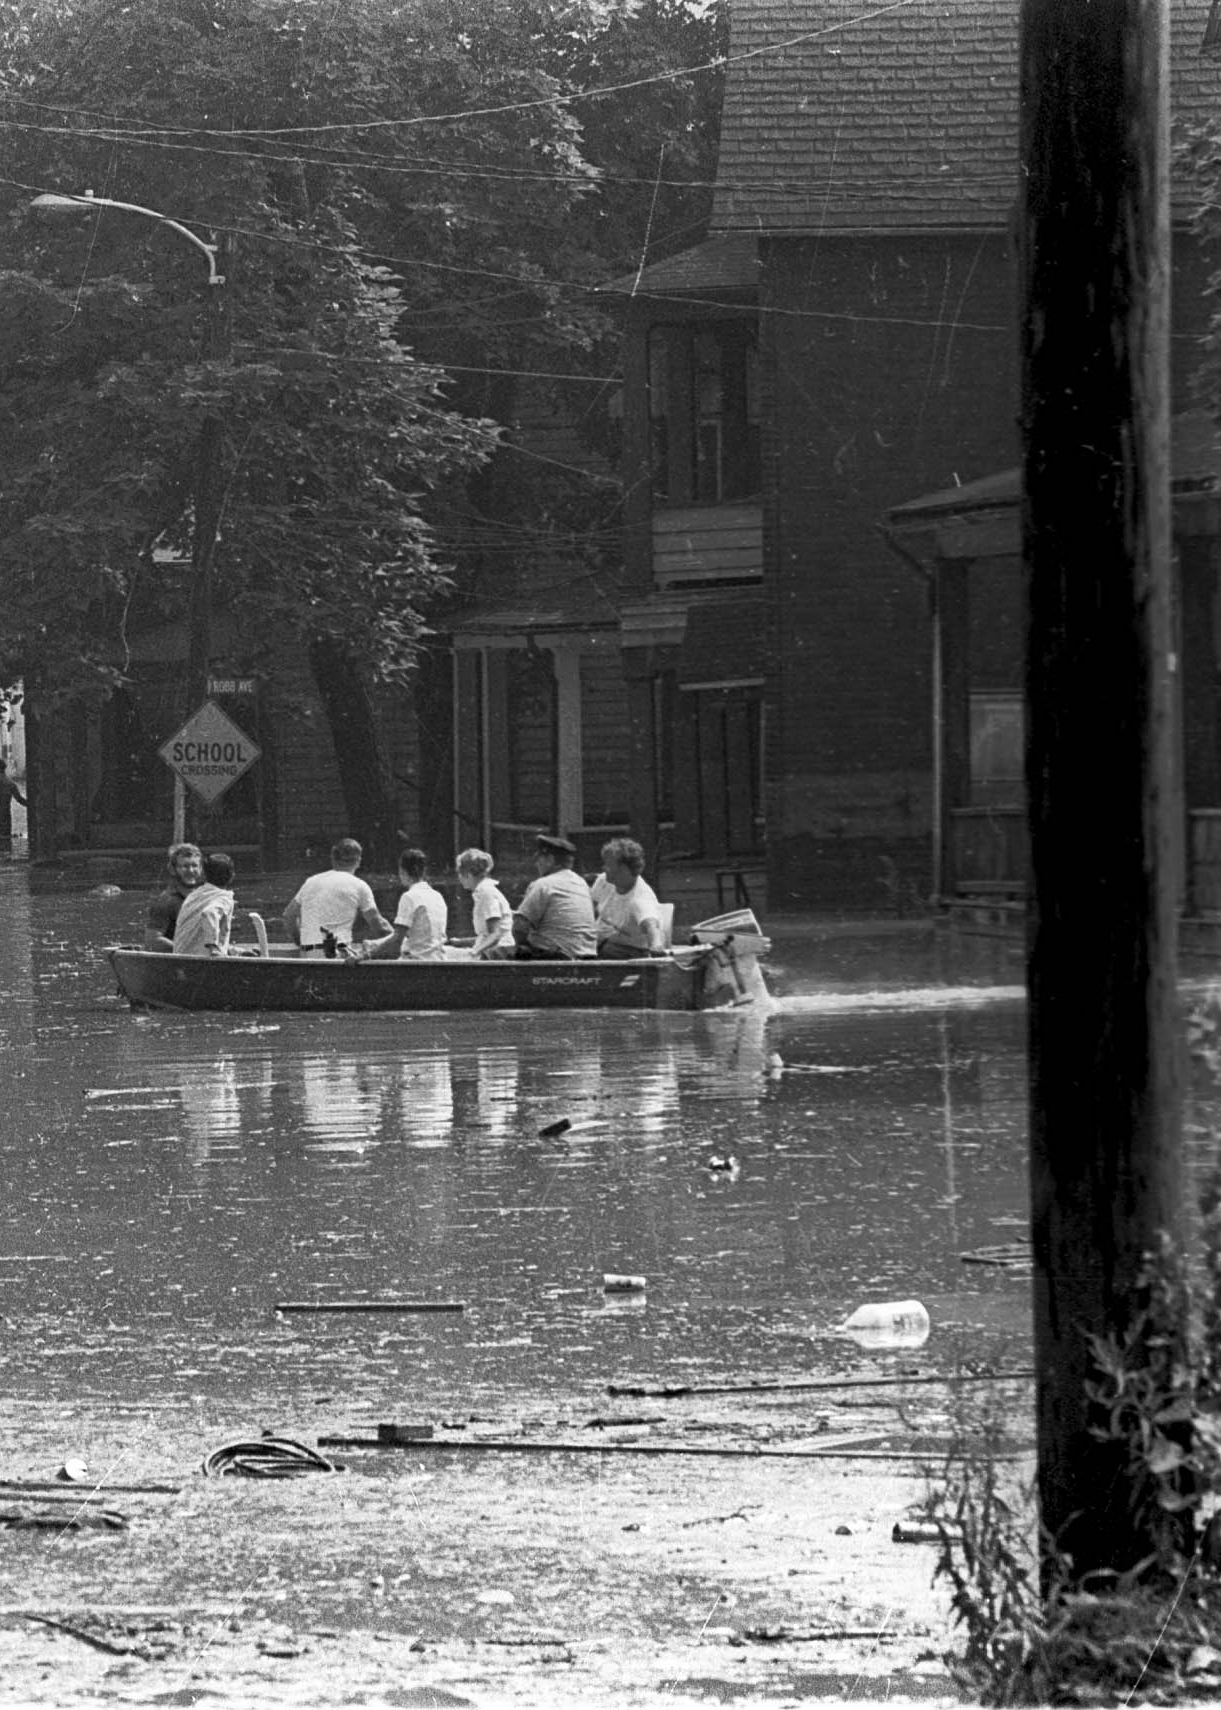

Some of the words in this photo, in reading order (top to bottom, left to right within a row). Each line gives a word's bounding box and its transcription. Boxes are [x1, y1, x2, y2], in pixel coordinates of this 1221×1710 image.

[173, 742, 247, 762] SCHOOL
[181, 764, 238, 776] CROSSING
[532, 977, 601, 985] STARCRAFT
